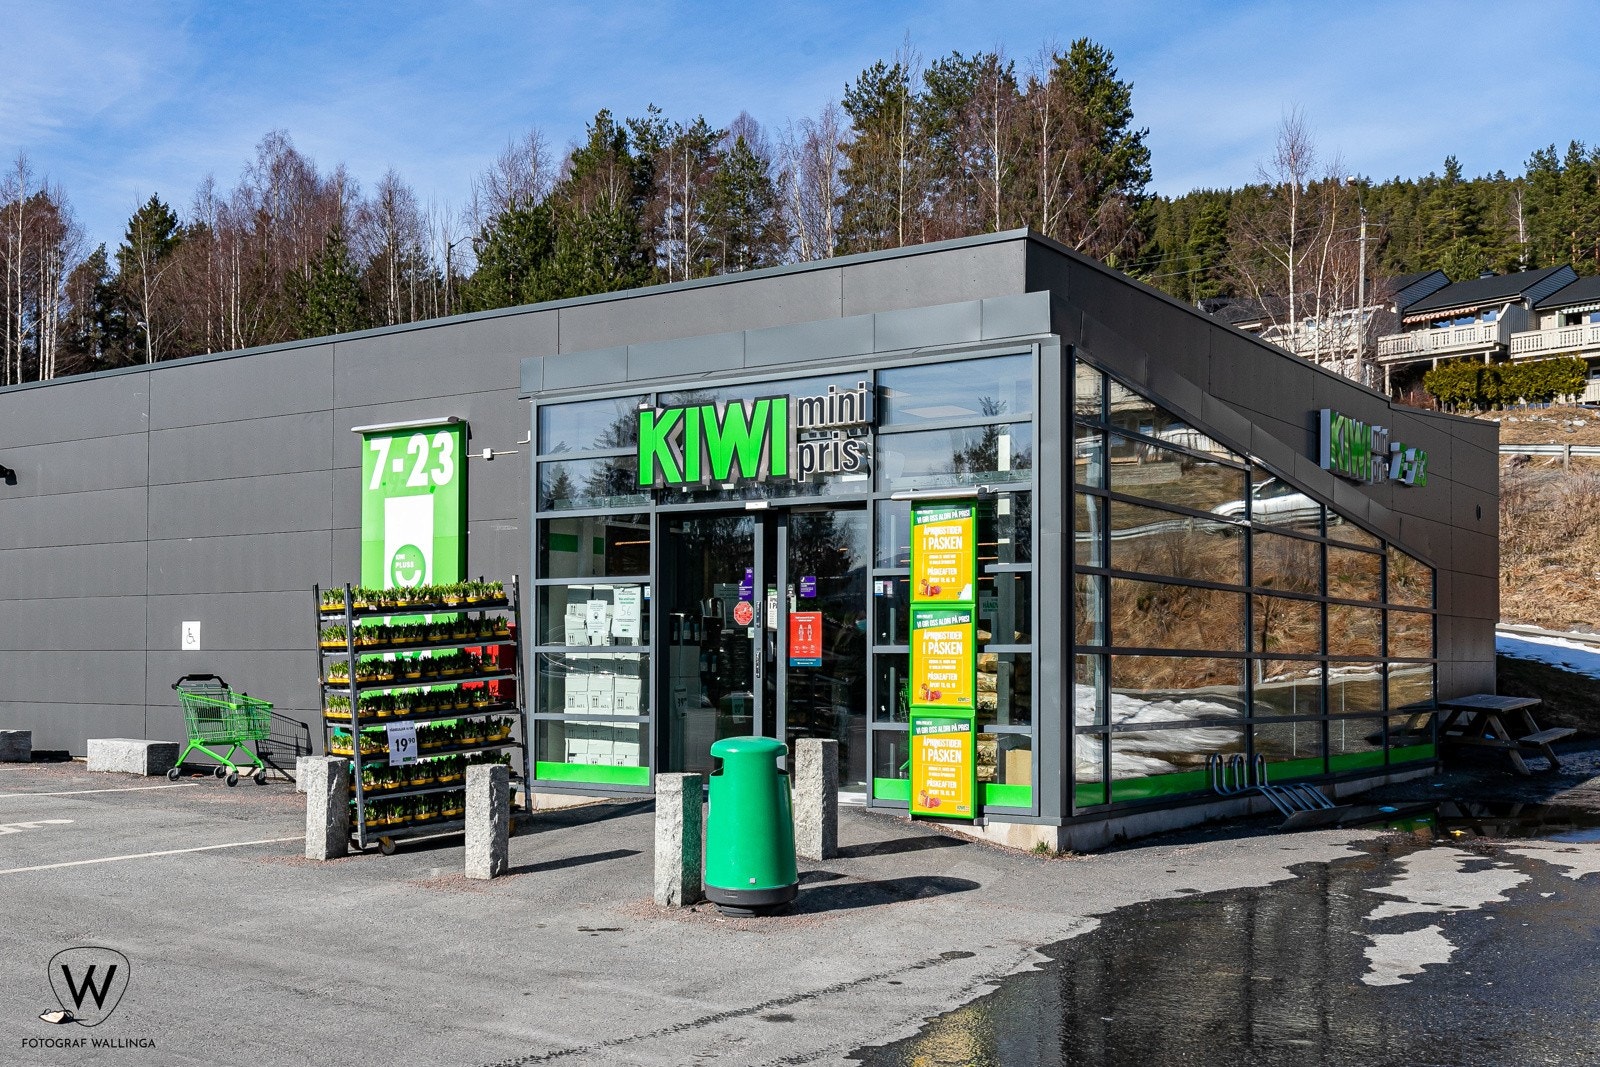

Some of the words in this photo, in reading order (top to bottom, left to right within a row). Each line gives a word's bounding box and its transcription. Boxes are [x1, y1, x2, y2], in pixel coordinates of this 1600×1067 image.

[637, 394, 789, 488] KIWI
[798, 381, 867, 428] mini
[1328, 411, 1371, 481] KIWI
[798, 430, 861, 482] pris
[928, 534, 963, 551] PÅSKEN
[396, 561, 415, 569] PLUSS
[928, 639, 963, 655] PÅSKEN
[928, 746, 962, 764] PÅSKEN
